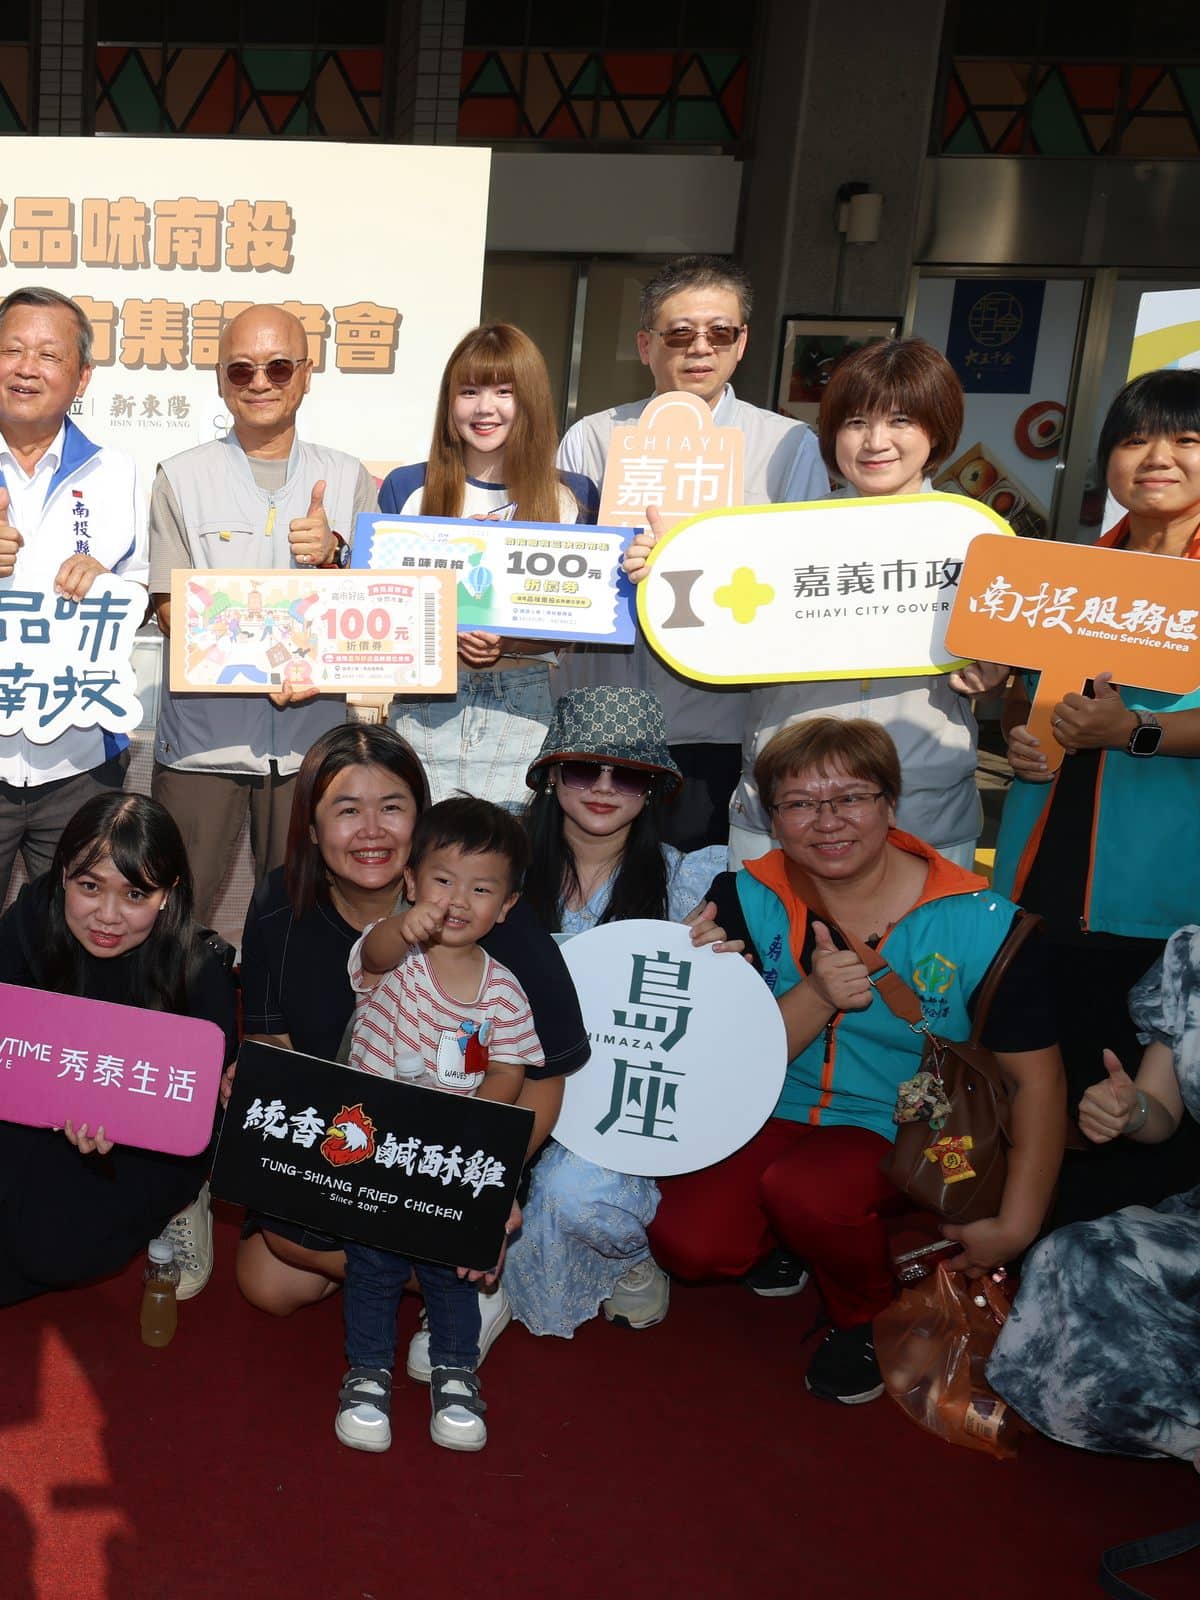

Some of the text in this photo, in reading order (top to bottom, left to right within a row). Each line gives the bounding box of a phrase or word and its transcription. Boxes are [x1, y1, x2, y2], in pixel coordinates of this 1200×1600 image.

[110, 394, 191, 419] 新東陽
[110, 420, 191, 428] HSIN TUNG YANG
[623, 435, 725, 452] CHIAYI
[615, 455, 726, 509] 嘉市
[71, 500, 93, 557] 南投縣
[506, 550, 602, 580] 100元
[793, 557, 964, 598] 嘉義市政
[523, 578, 580, 594] 折價券
[795, 602, 950, 619] CHIAYI CITY GOVER
[969, 575, 1200, 641] 南投服務區
[320, 608, 410, 641] 100元
[1077, 627, 1190, 652] Nantou Service Area
[594, 950, 693, 1143] 島座
[57, 1047, 196, 1103] 秀泰生活
[444, 1069, 467, 1080] WAVES
[242, 1098, 507, 1199] 統香 鹹酥雞
[260, 1157, 463, 1221] TUNG-SHIANG FRIED CHICKEN
[329, 1191, 379, 1214] Since 2019
